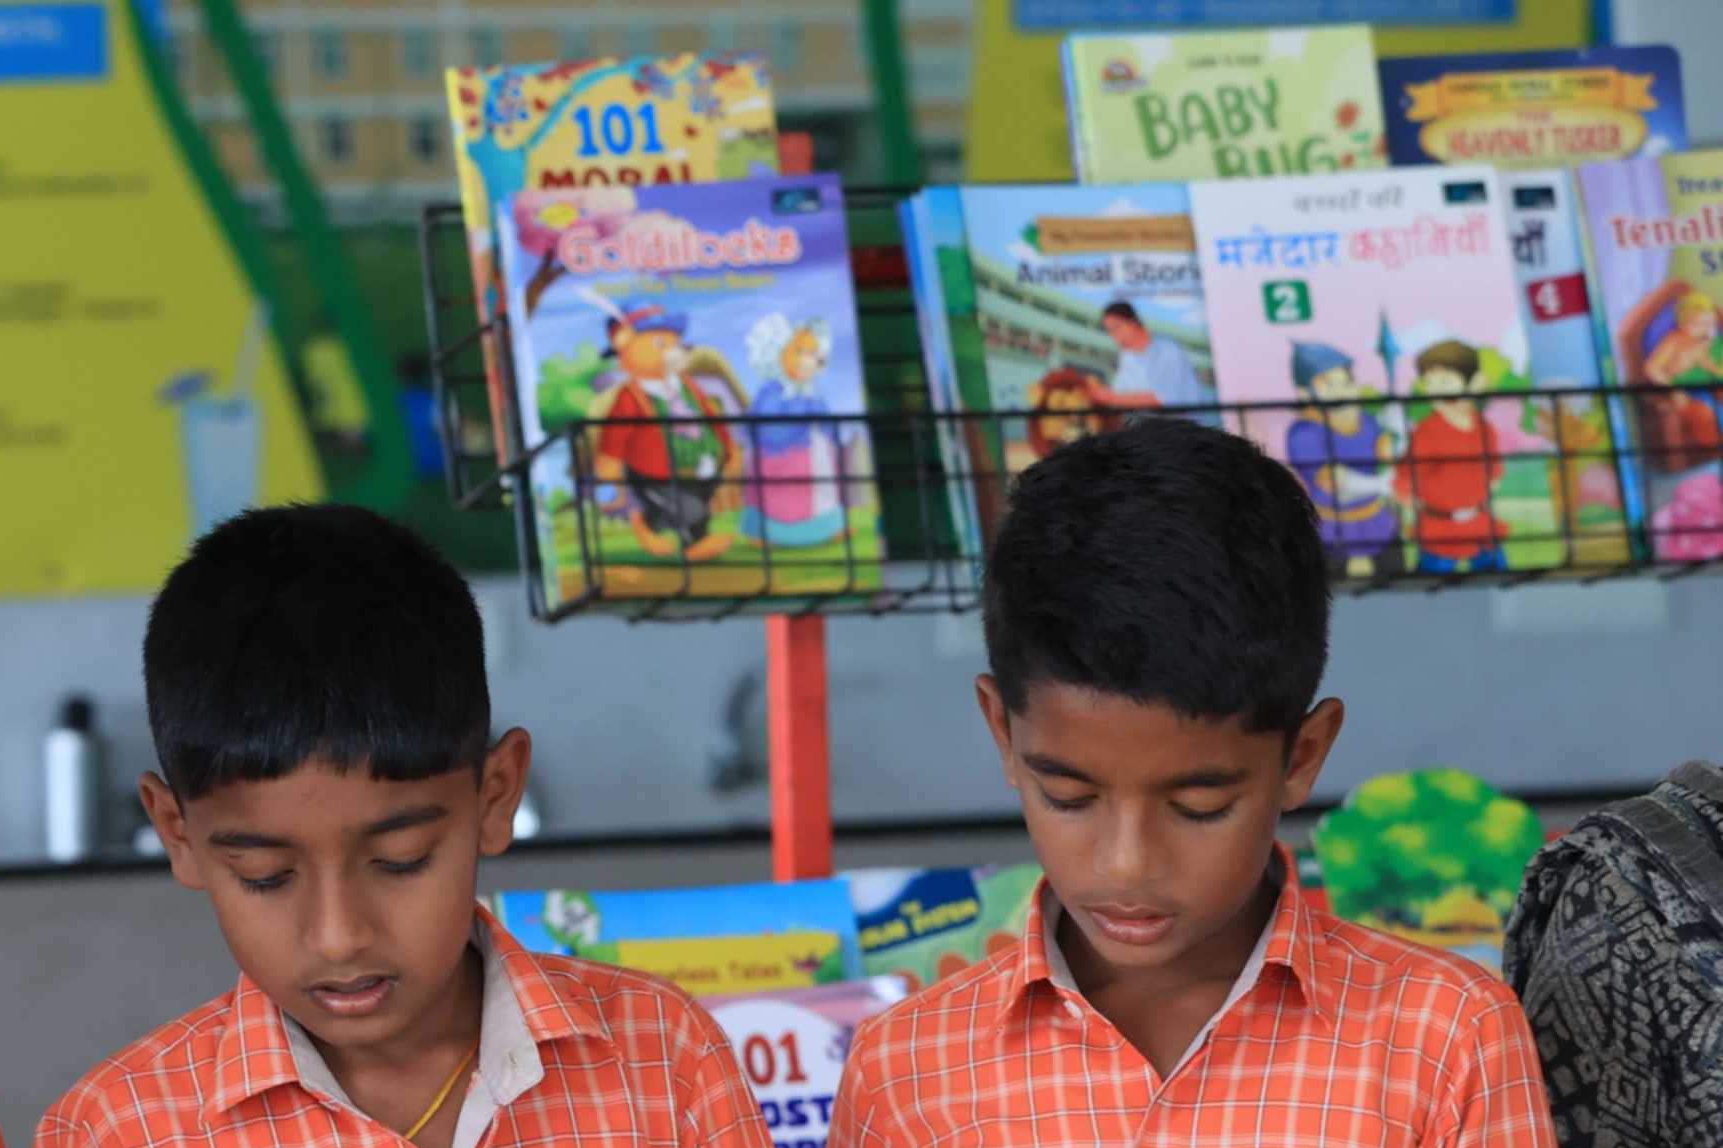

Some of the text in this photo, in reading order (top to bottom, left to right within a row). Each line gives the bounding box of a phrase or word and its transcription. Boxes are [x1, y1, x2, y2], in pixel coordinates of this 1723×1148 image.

[573, 102, 665, 156] 101
[1134, 76, 1280, 161] BABY
[558, 217, 802, 274] Goldilocks
[1016, 261, 1113, 285] Animal
[1271, 285, 1301, 322] 2
[1535, 284, 1561, 315] 4
[744, 1030, 807, 1086] 01
[760, 1097, 833, 1129] OST
